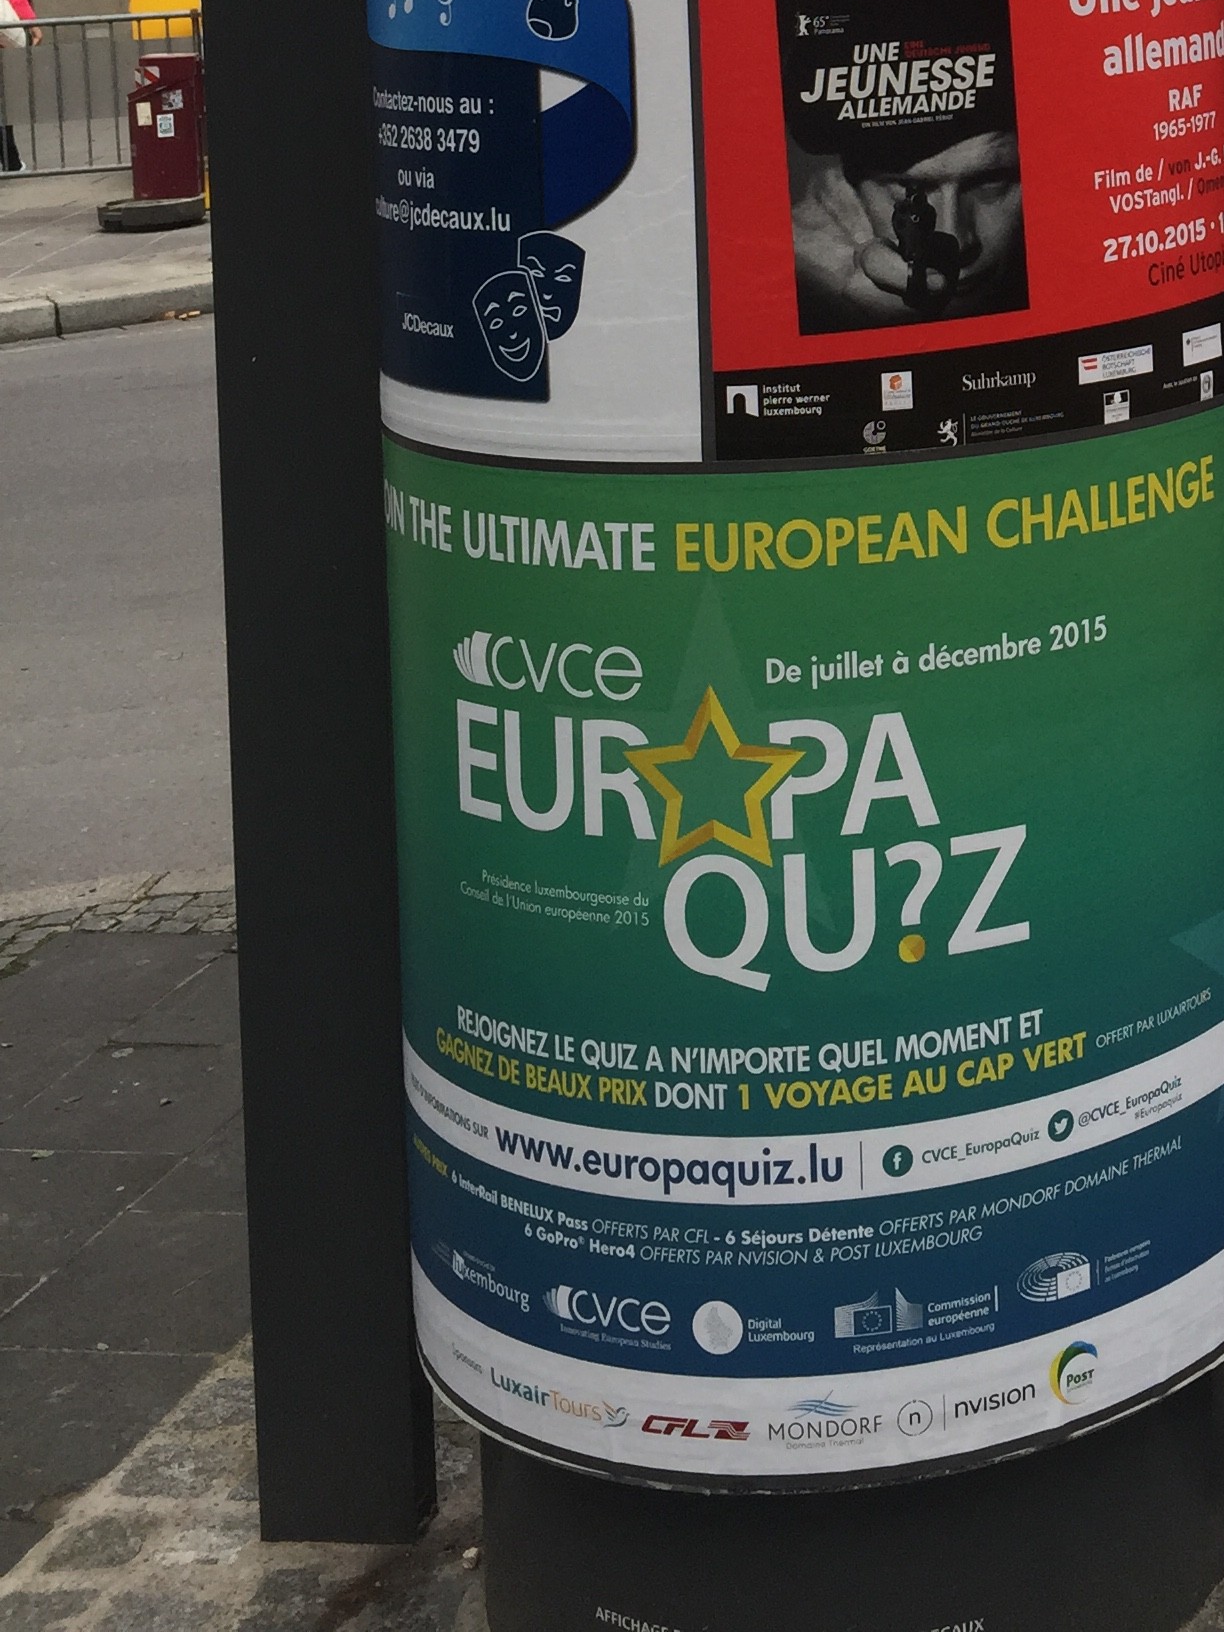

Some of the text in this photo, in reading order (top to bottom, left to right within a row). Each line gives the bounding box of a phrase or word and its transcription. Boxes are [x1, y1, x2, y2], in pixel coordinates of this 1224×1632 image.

[854, 42, 899, 63] UNE
[800, 54, 996, 103] JEUNESSE
[459, 97, 482, 114] au
[837, 89, 976, 120] ALLEMANDE
[1169, 84, 1202, 111] RAF
[1153, 111, 1216, 140] 1965-1977
[401, 127, 480, 153] 2638 3479
[398, 167, 434, 189] ou via
[1094, 164, 1153, 190] Film de
[1103, 218, 1205, 263] 27.10.2015
[763, 384, 800, 393] institut
[962, 371, 1036, 391] Suhrkamp
[764, 407, 821, 416] luxembourg
[409, 455, 1214, 572] THE ULTIMATE EUROPEAN CHALLENGE
[766, 615, 1106, 689] De juillet à décembre 2015
[482, 869, 649, 906] Présidence luxembourgeoise du
[492, 891, 649, 926] de 2015
[457, 1005, 1043, 1073] REJOIGNEZ LE QUIZ QUEL MOMENT ET
[436, 1018, 1154, 1111] GAGNEZ DE BEAUX PRIX DONT 1 VOYAGE AU CAP VERT OFFERT PAR
[496, 1126, 842, 1198] www.europaquiz.lu
[500, 1195, 977, 1249] BENELUX Pass OFFERTS PAR CFL Séjours Détente OFFERTS PAR
[590, 1239, 870, 1265] Hero4 OFFERTS PAR POST
[927, 1291, 990, 1312] Commission
[748, 1318, 781, 1332] Digital
[928, 1307, 989, 1327] européenne
[748, 1328, 814, 1343] Luxembourg
[768, 1415, 883, 1440] MONDORF
